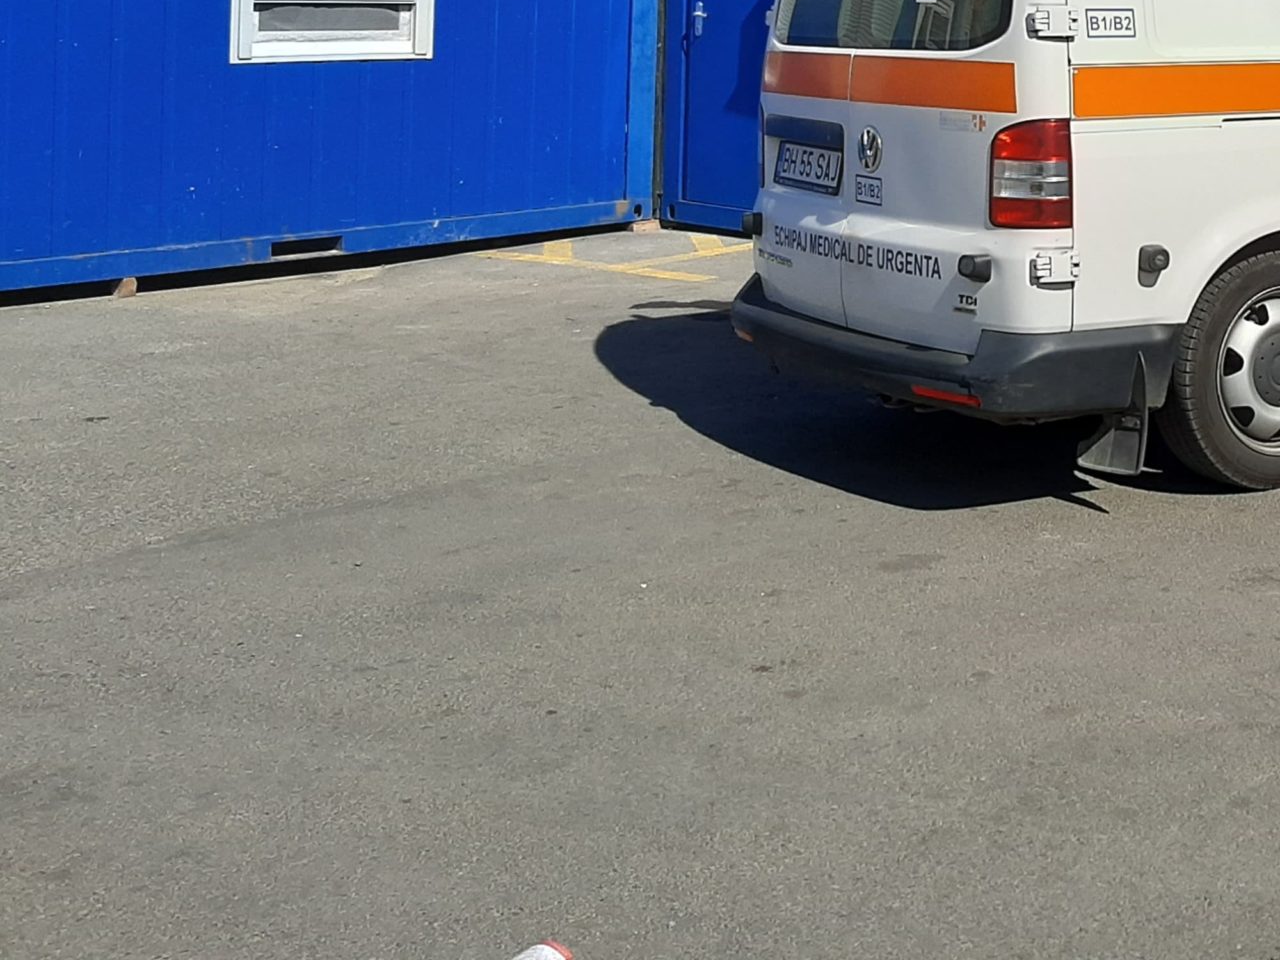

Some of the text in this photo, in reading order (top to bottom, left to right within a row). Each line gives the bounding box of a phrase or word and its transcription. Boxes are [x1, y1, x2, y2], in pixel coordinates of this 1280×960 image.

[1090, 16, 1132, 31] B1/B2
[781, 146, 841, 182] BH 55 SAJ
[856, 180, 881, 200] B1/B2
[774, 225, 808, 252] ECHIPAJ
[809, 233, 855, 264] MEDICAL
[857, 244, 874, 268] DE
[876, 247, 942, 280] URGENTA
